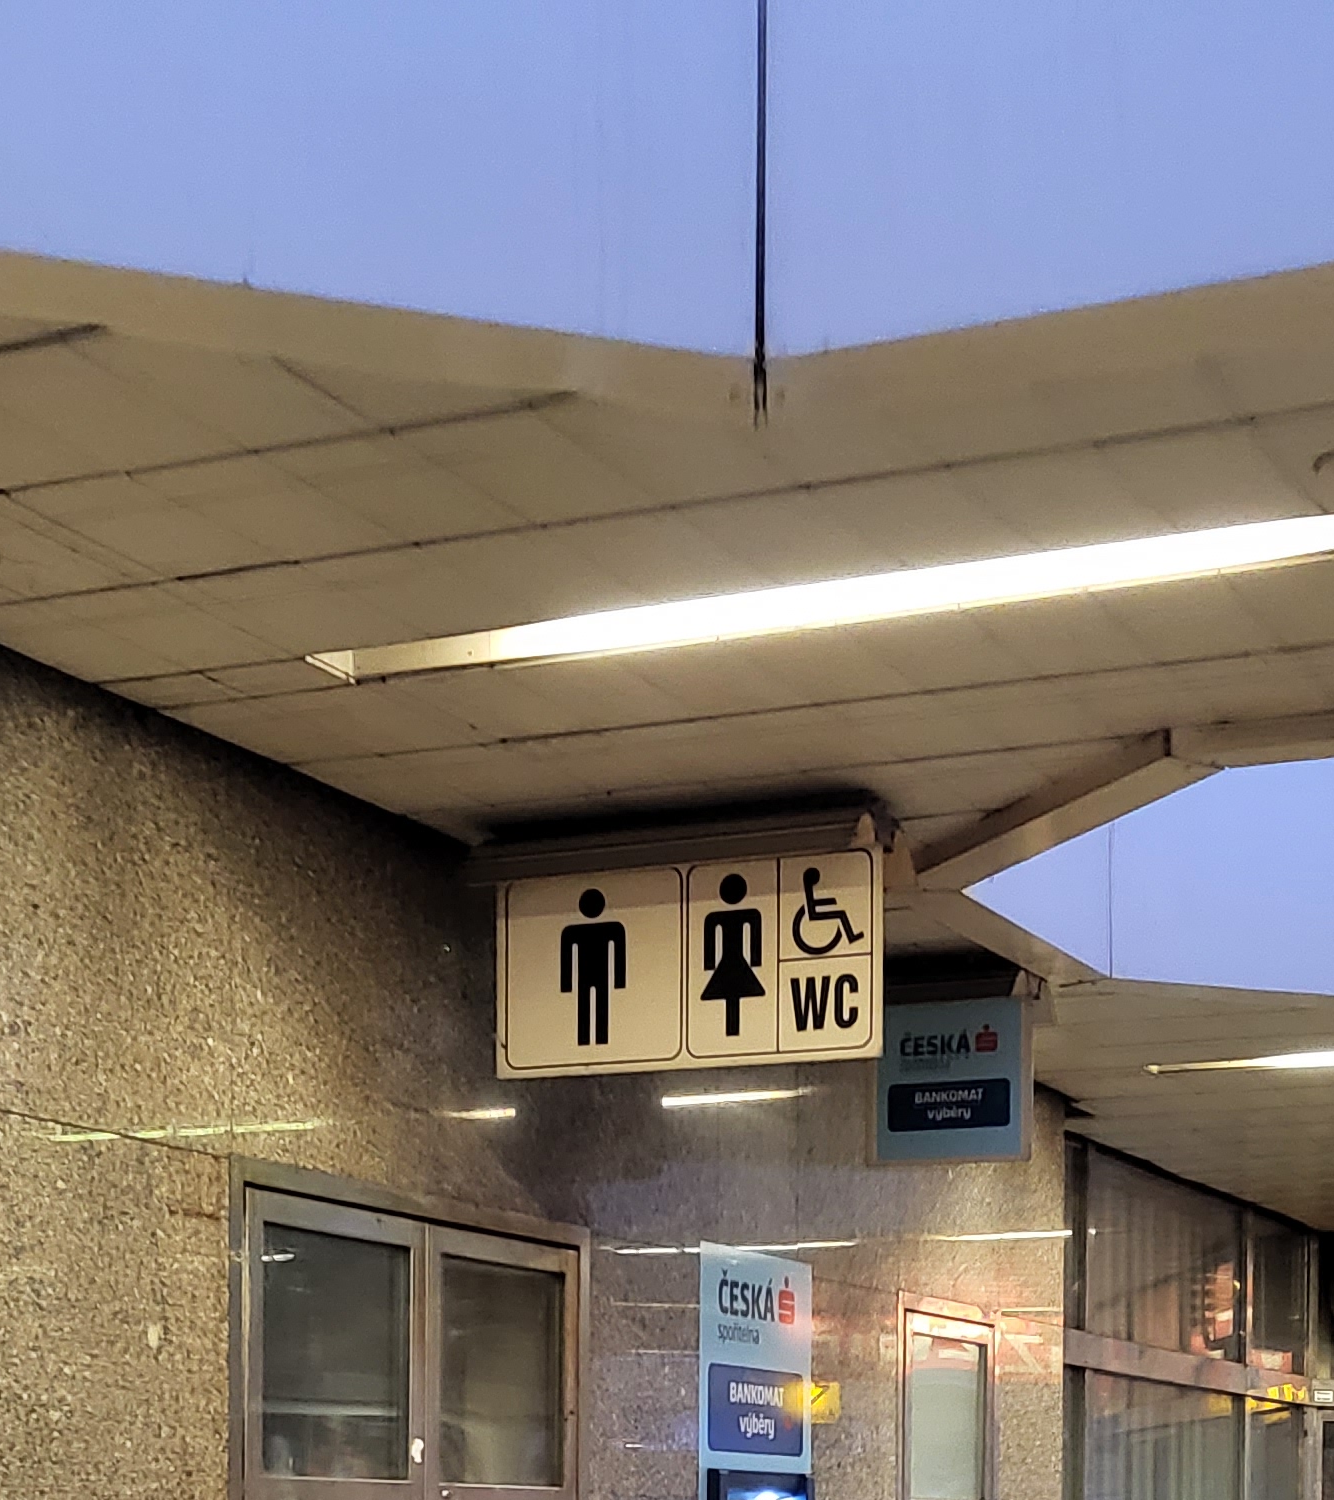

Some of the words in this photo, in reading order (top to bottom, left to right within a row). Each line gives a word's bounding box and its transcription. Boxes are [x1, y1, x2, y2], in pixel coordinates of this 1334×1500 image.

[789, 973, 859, 1032] WC
[899, 1030, 971, 1056] ČESKÁ
[914, 1088, 984, 1104] BANKOMAT
[926, 1105, 972, 1121] výběry
[718, 1269, 775, 1322] ČESKÁ
[718, 1322, 760, 1345] spořitelna
[729, 1381, 784, 1408] BANKOMAT
[739, 1412, 775, 1440] výběry
